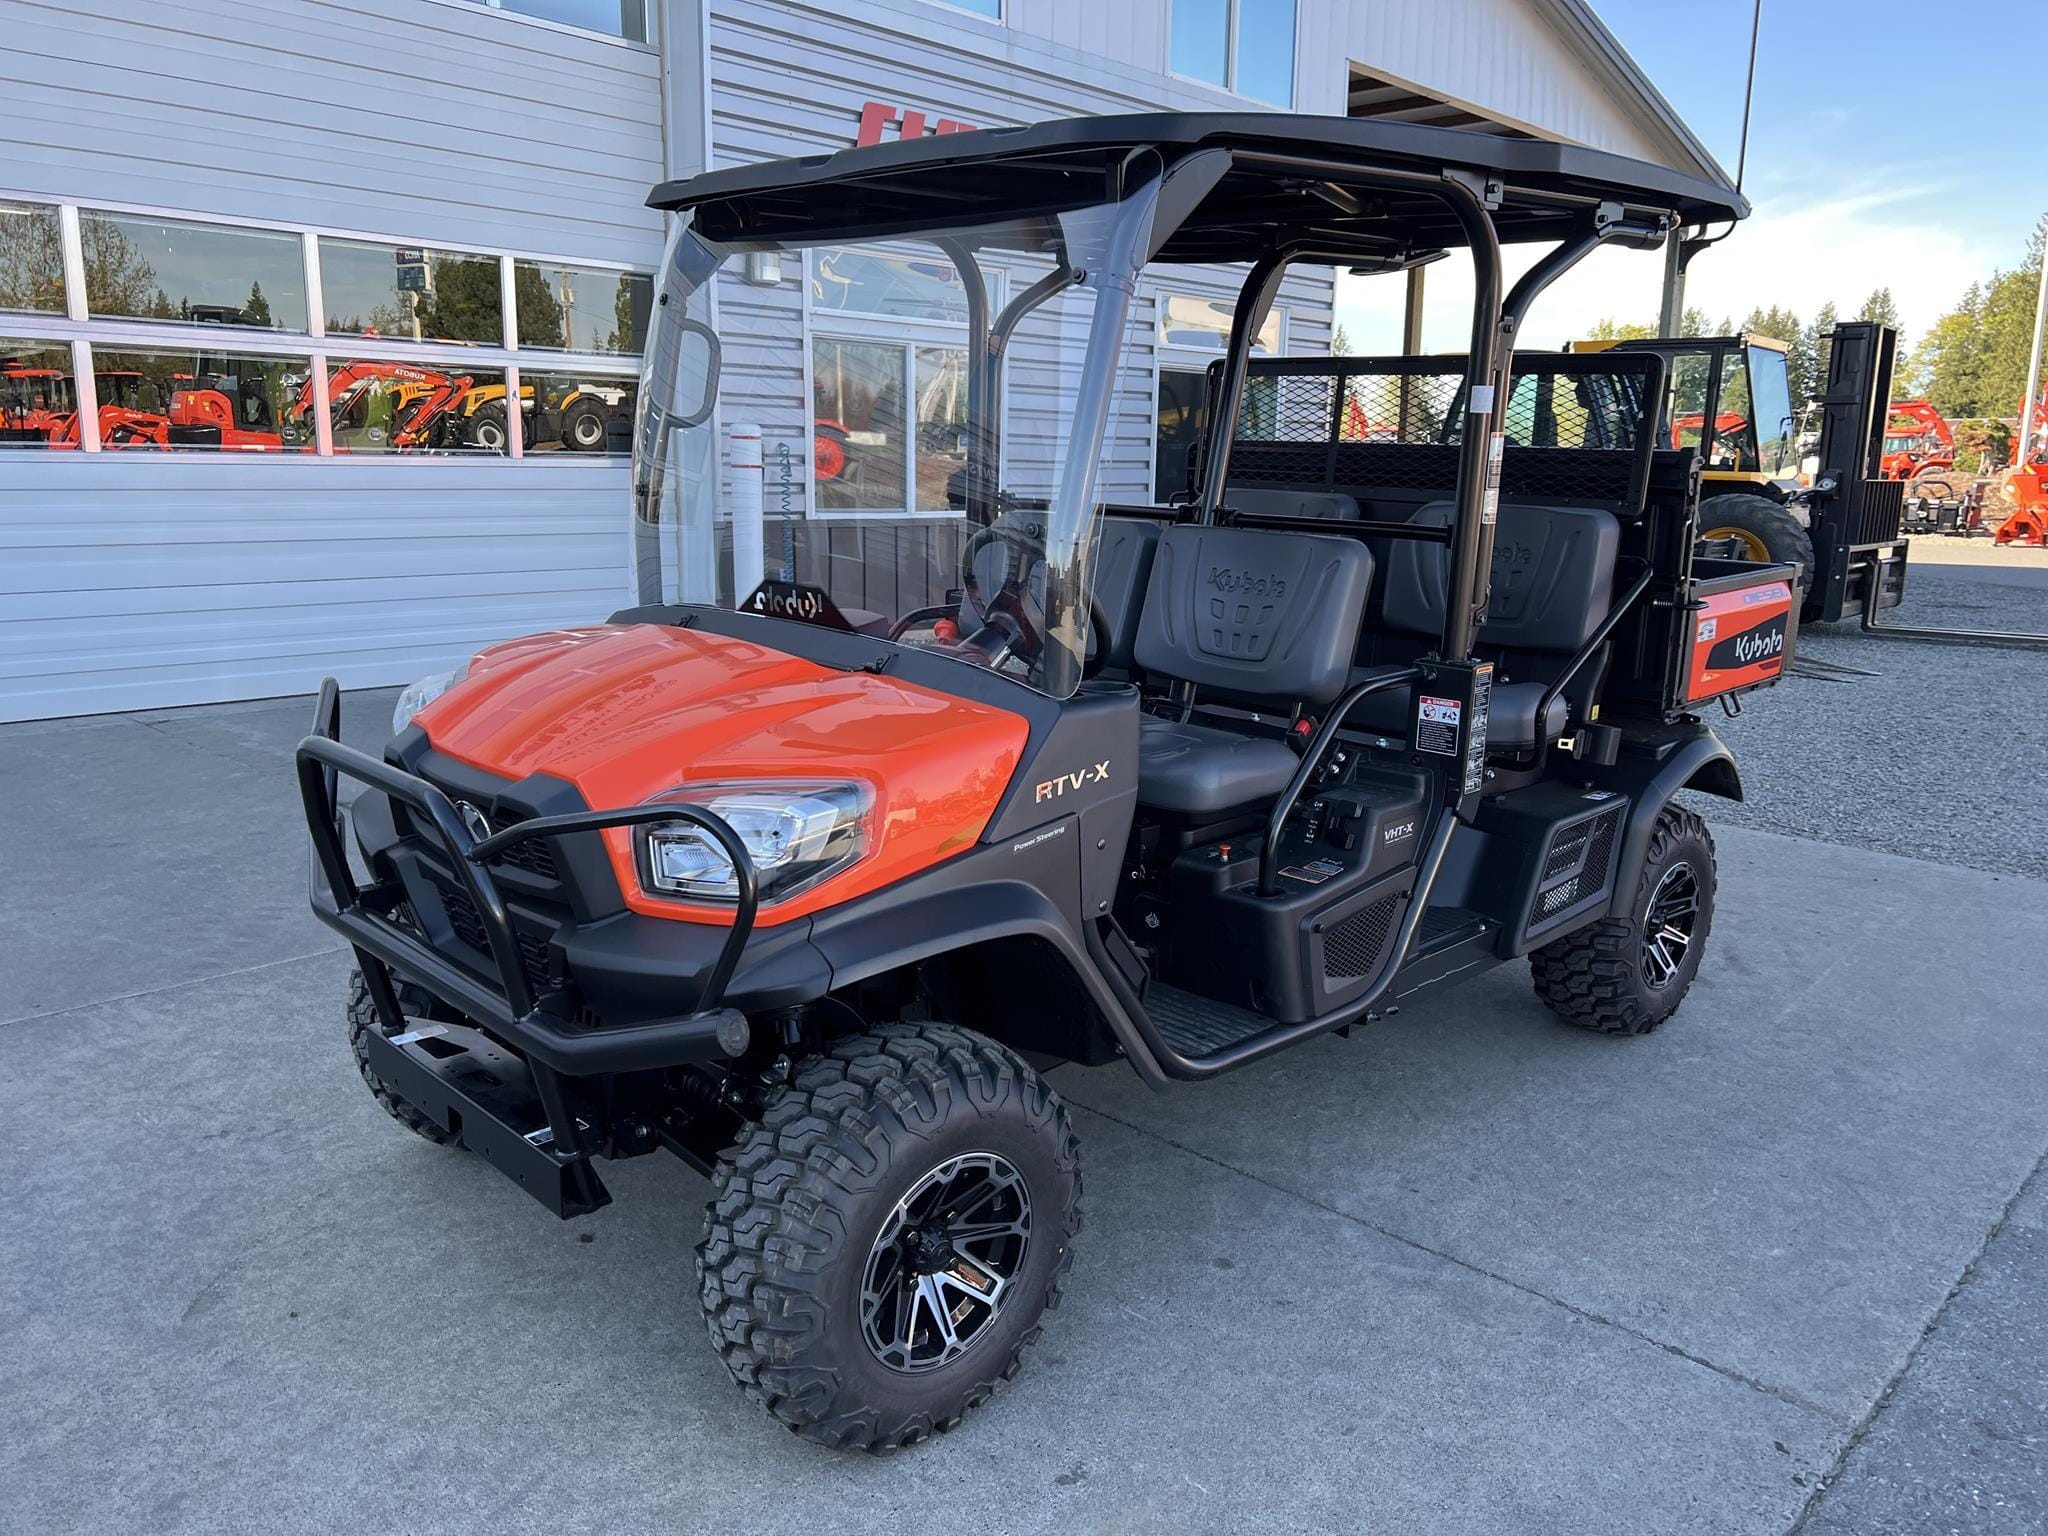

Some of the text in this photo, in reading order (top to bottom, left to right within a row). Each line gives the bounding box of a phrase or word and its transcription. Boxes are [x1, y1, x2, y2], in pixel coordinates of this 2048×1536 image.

[1206, 567, 1286, 598] Kubota
[1735, 628, 1783, 662] Kubota
[1035, 760, 1110, 804] RTV-X
[1014, 826, 1065, 852] Power Steering
[1384, 822, 1414, 840] VHT-X
